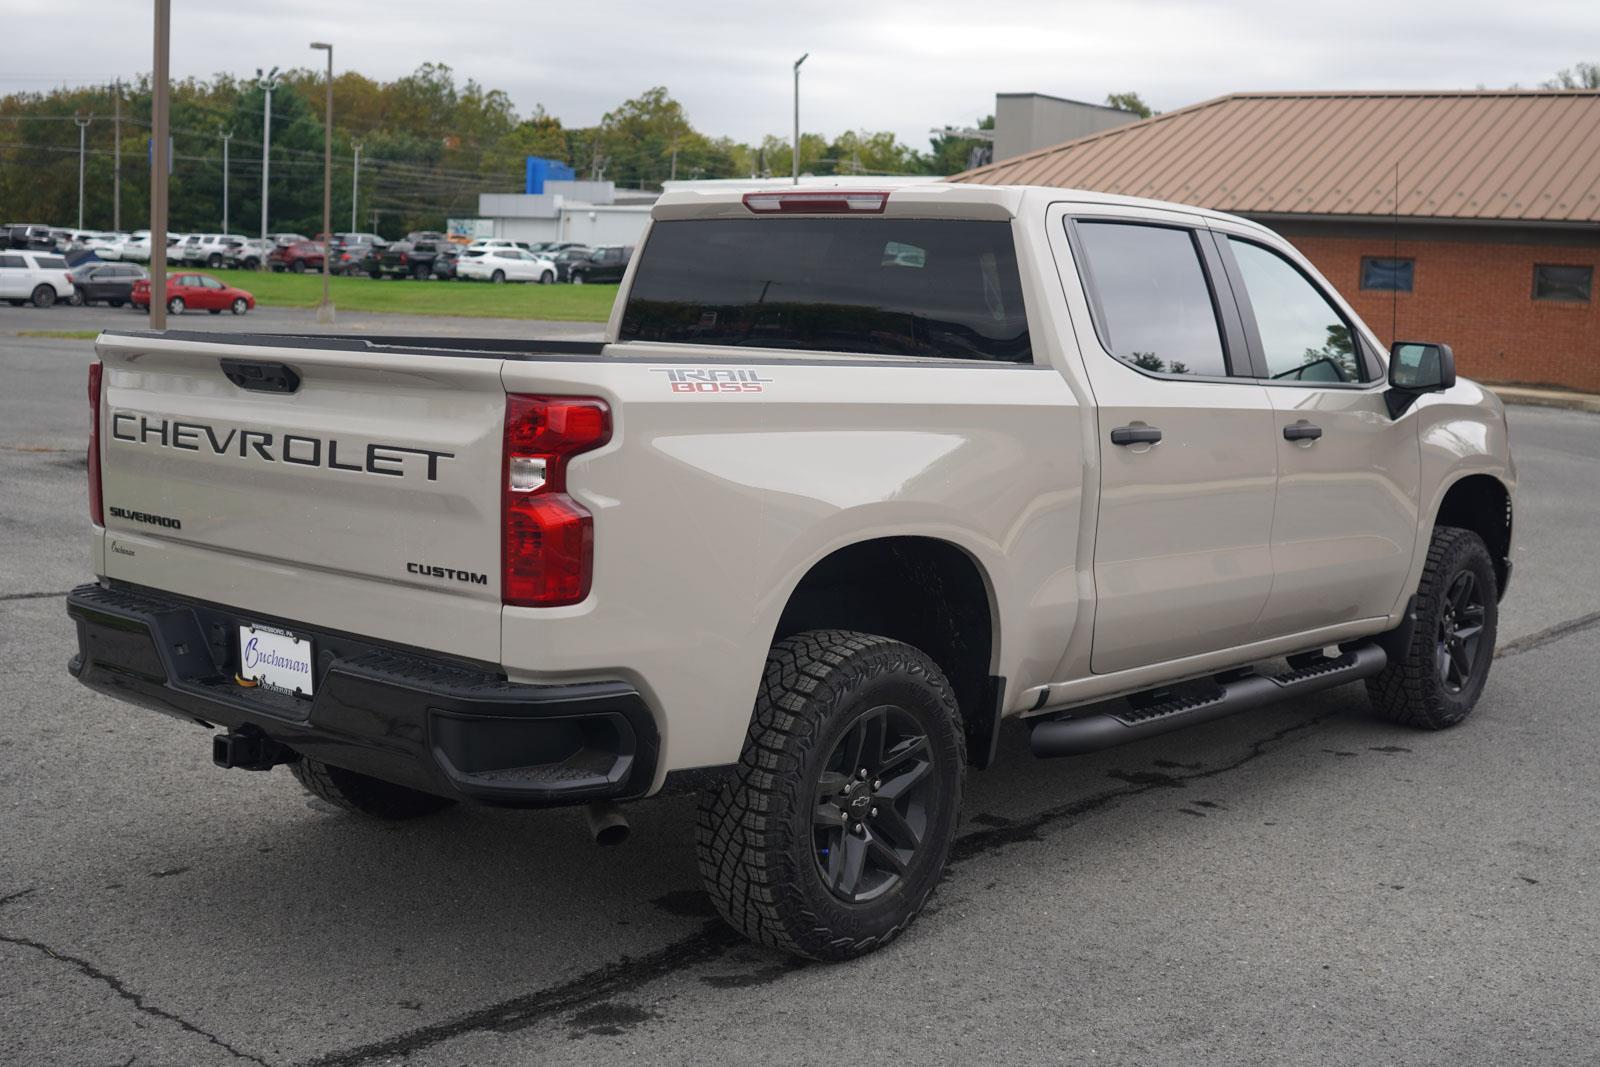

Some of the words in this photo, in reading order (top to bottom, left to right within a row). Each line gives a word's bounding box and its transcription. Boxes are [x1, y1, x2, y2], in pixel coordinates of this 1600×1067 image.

[649, 368, 773, 382] TRAIL
[671, 382, 763, 393] BOSS
[113, 414, 454, 481] CHEVROLET
[109, 506, 182, 530] SILVERADO
[406, 562, 488, 585] CUSTOM
[245, 637, 309, 674] Buchanan
